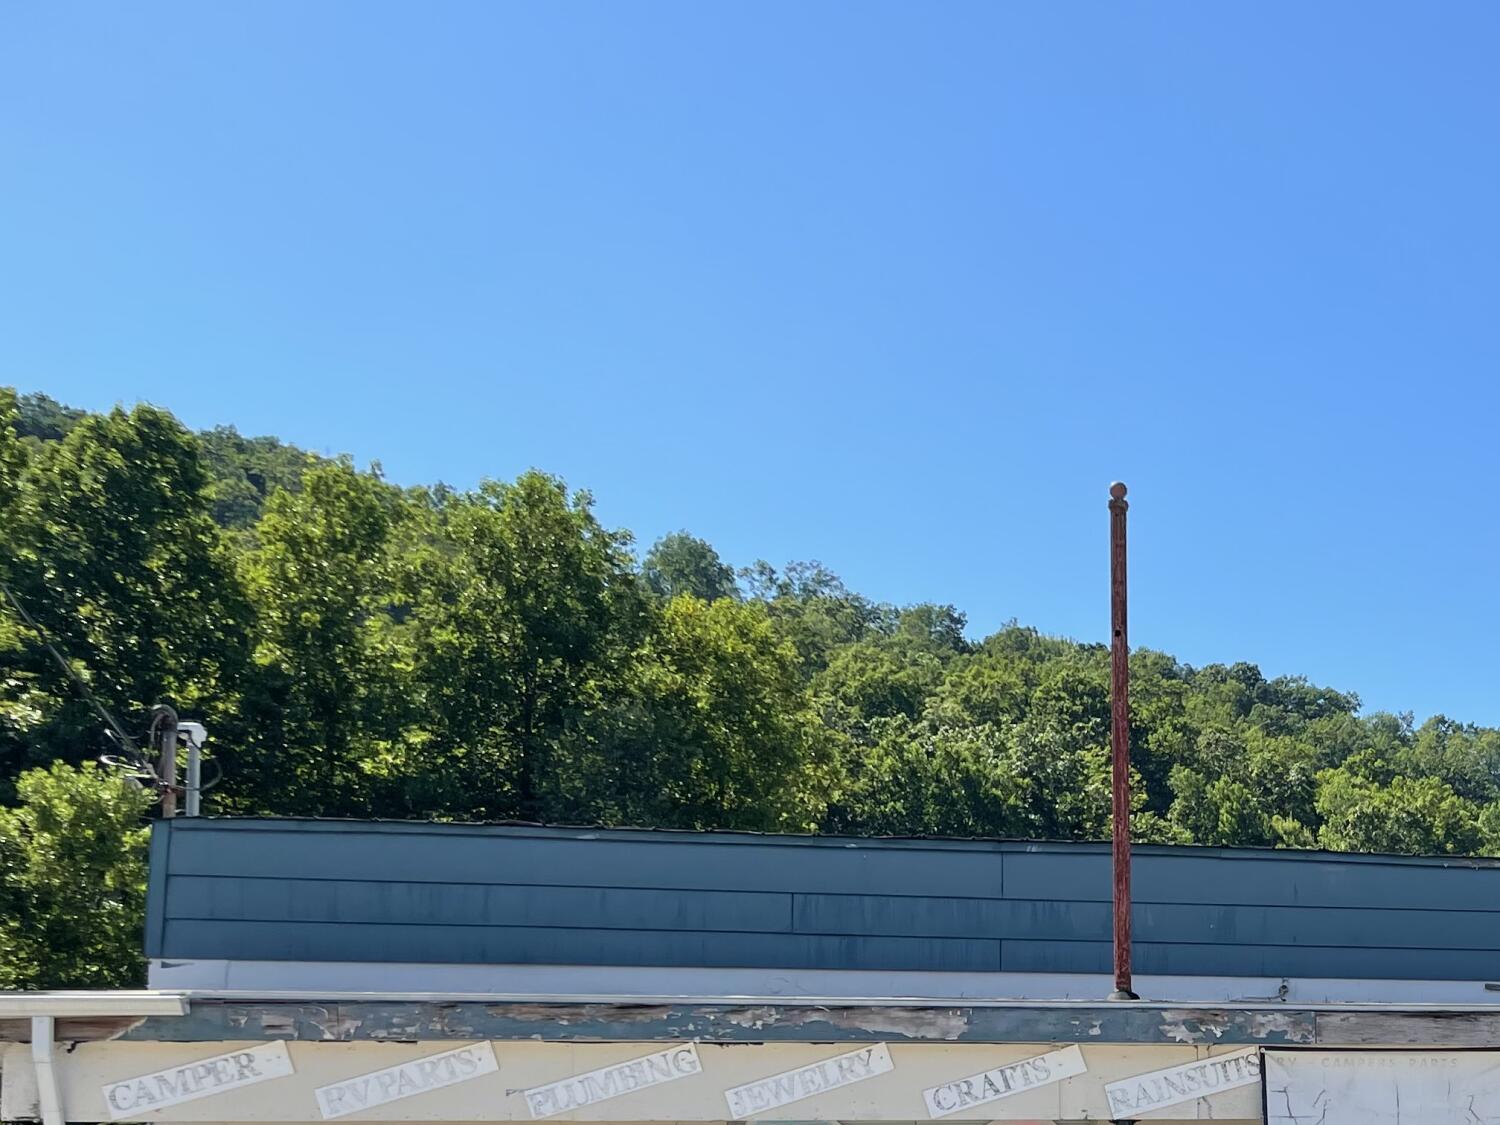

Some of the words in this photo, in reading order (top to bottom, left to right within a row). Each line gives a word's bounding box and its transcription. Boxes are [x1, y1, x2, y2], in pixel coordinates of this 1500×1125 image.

[109, 1053, 262, 1111] CAMPER
[322, 1080, 372, 1115] RV
[374, 1050, 478, 1097] PARTS
[527, 1050, 698, 1115] PLUMBING
[734, 1049, 876, 1116] JEWELRY
[934, 1057, 1051, 1110] CRAFTS
[1109, 1053, 1261, 1115] RAINSUITS
